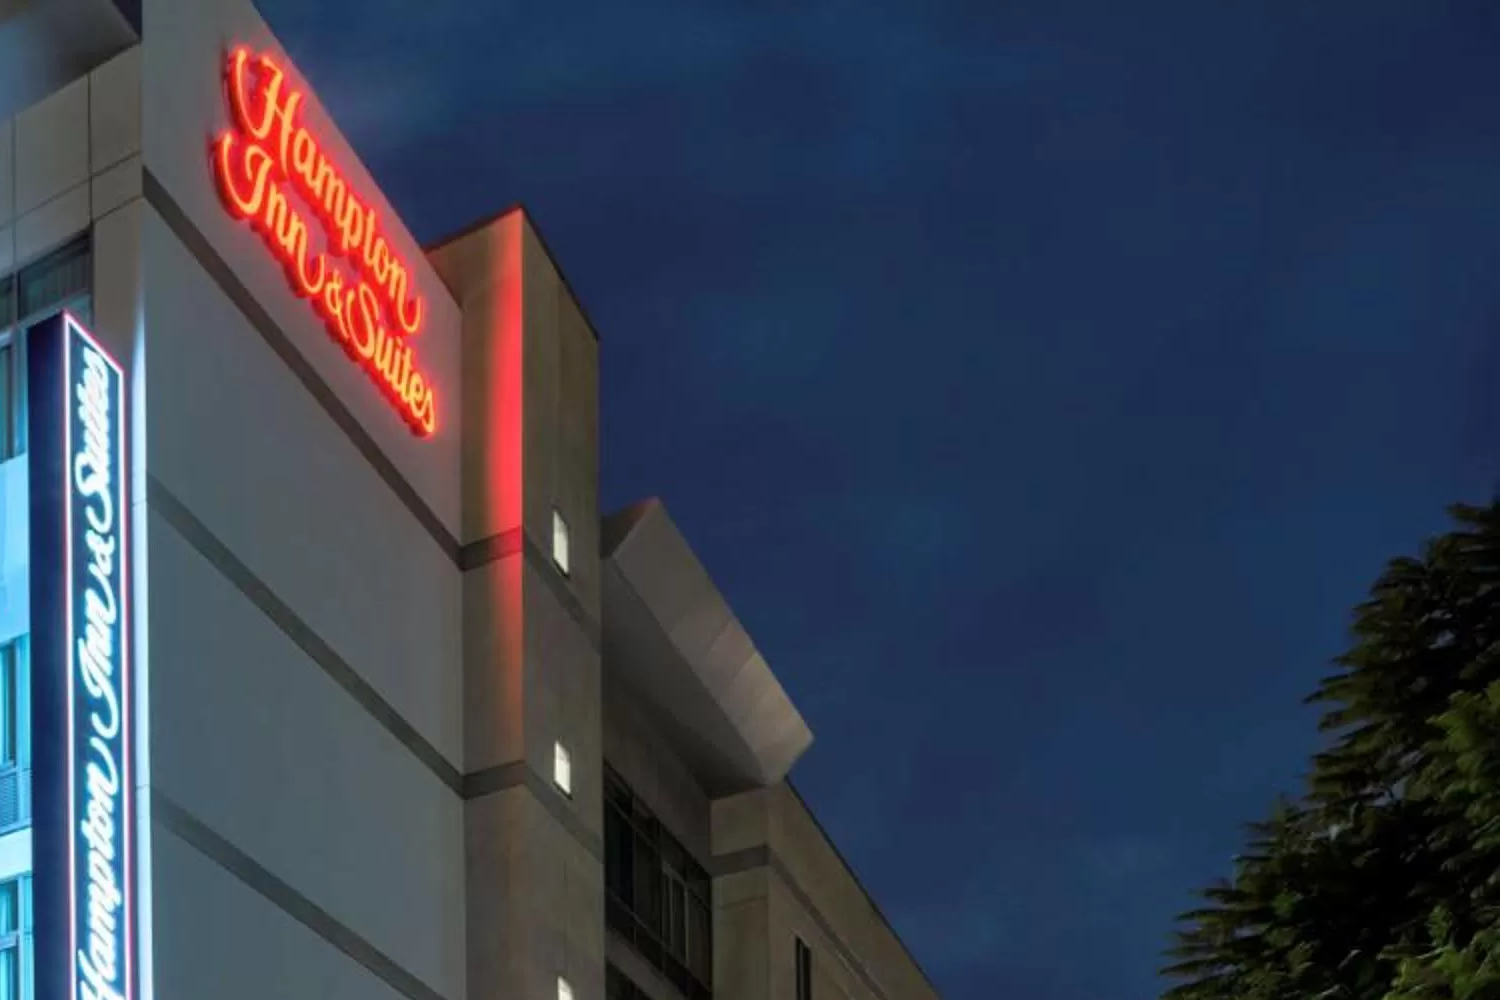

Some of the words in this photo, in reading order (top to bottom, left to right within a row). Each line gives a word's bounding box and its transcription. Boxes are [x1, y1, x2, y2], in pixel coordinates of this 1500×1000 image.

[213, 129, 327, 296] Inn
[345, 281, 438, 436] Suites
[225, 44, 423, 334] Hampton
[74, 346, 114, 534] Suites
[77, 562, 119, 740] Inn
